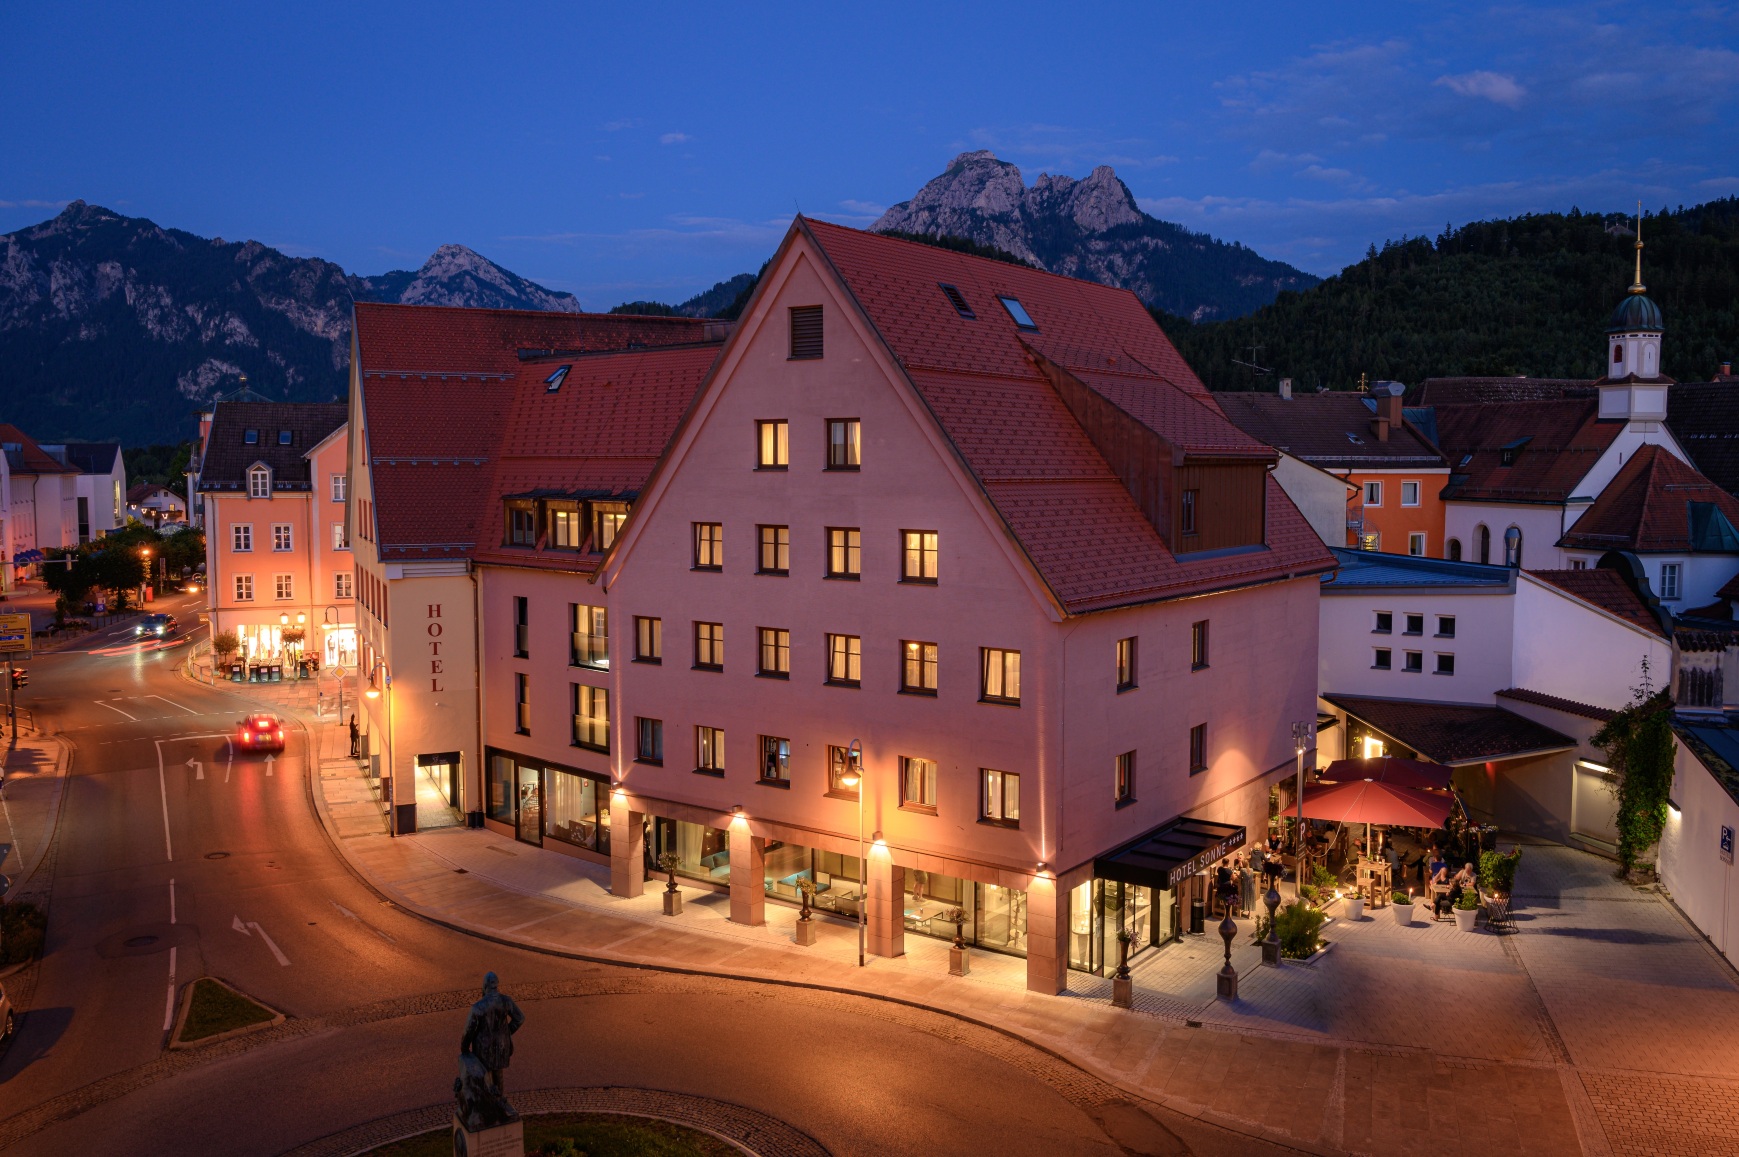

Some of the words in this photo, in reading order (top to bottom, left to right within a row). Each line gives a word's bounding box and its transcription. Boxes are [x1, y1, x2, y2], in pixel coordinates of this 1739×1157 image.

[427, 603, 444, 692] HOTEL
[1722, 827, 1728, 840] P
[1169, 860, 1197, 886] HOTEL
[1200, 842, 1227, 868] SONNE
